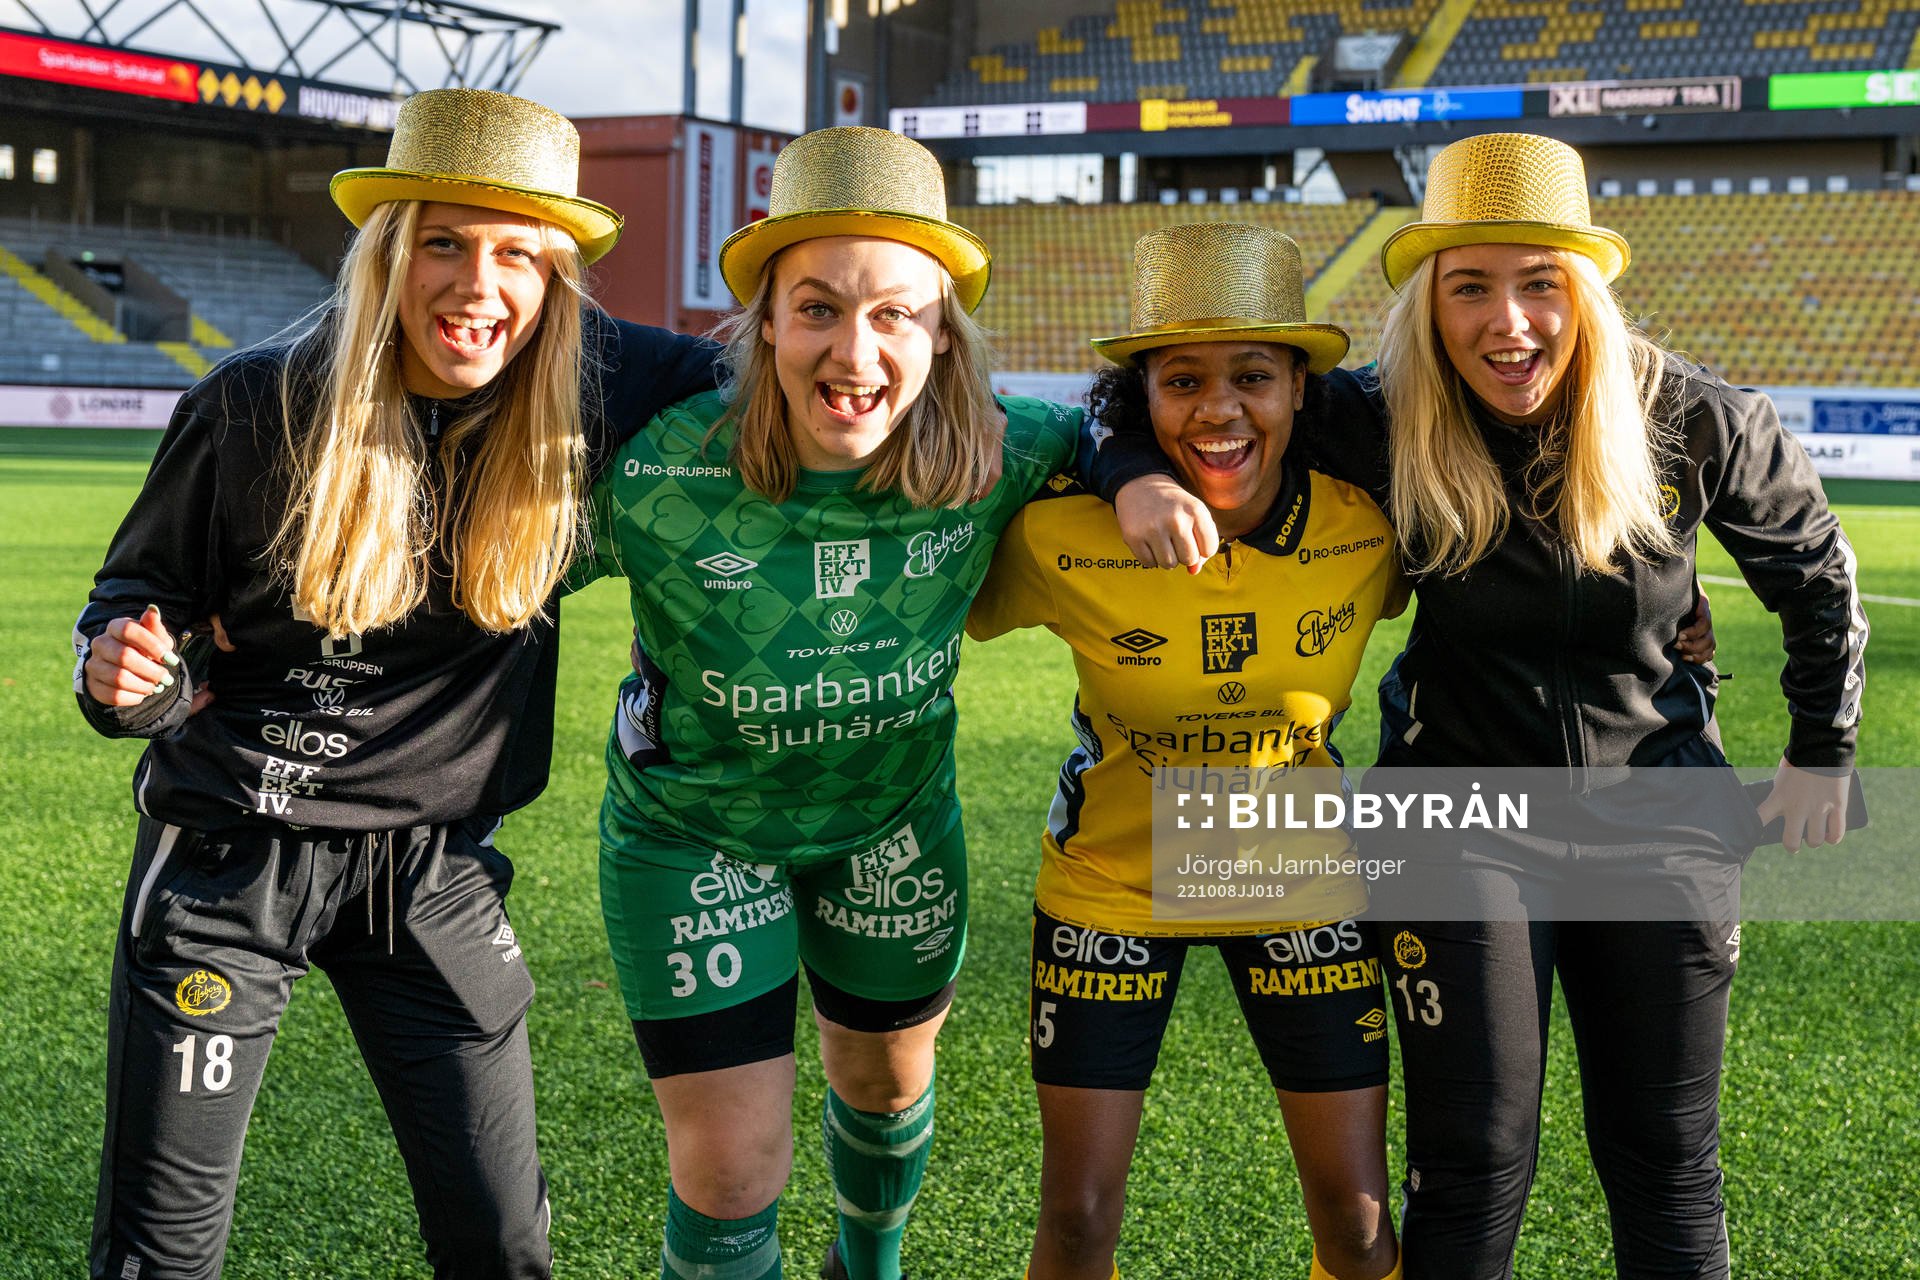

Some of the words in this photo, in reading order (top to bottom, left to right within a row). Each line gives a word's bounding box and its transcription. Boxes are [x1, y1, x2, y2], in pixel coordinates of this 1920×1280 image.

[642, 464, 732, 478] RO-GRUPPEN
[819, 543, 860, 562] EFF
[904, 521, 975, 578] Elfsborg
[1313, 536, 1385, 560] RO-GRUPPEN
[819, 559, 866, 578] EKT
[703, 579, 753, 590] umbro
[1205, 617, 1247, 636] EFF
[1295, 601, 1356, 658] Elfsborg
[786, 642, 870, 659] TOVEKS
[875, 637, 900, 650] BIL
[1206, 633, 1253, 653] EKT
[1117, 655, 1162, 666] umbro
[702, 633, 960, 719] Sparbanken
[1175, 710, 1256, 722] TOVEKS
[261, 719, 349, 758] ellos
[262, 755, 321, 782] EFF
[258, 774, 324, 797] EKT
[814, 888, 958, 939] RAMIRENT
[916, 942, 952, 964] umbro
[1052, 925, 1150, 966] ellos
[1263, 919, 1363, 963] ellos
[666, 942, 743, 998] 30
[1034, 960, 1168, 1001] RAMIRENT
[1396, 973, 1443, 1026] 13
[172, 1034, 234, 1092] 18
